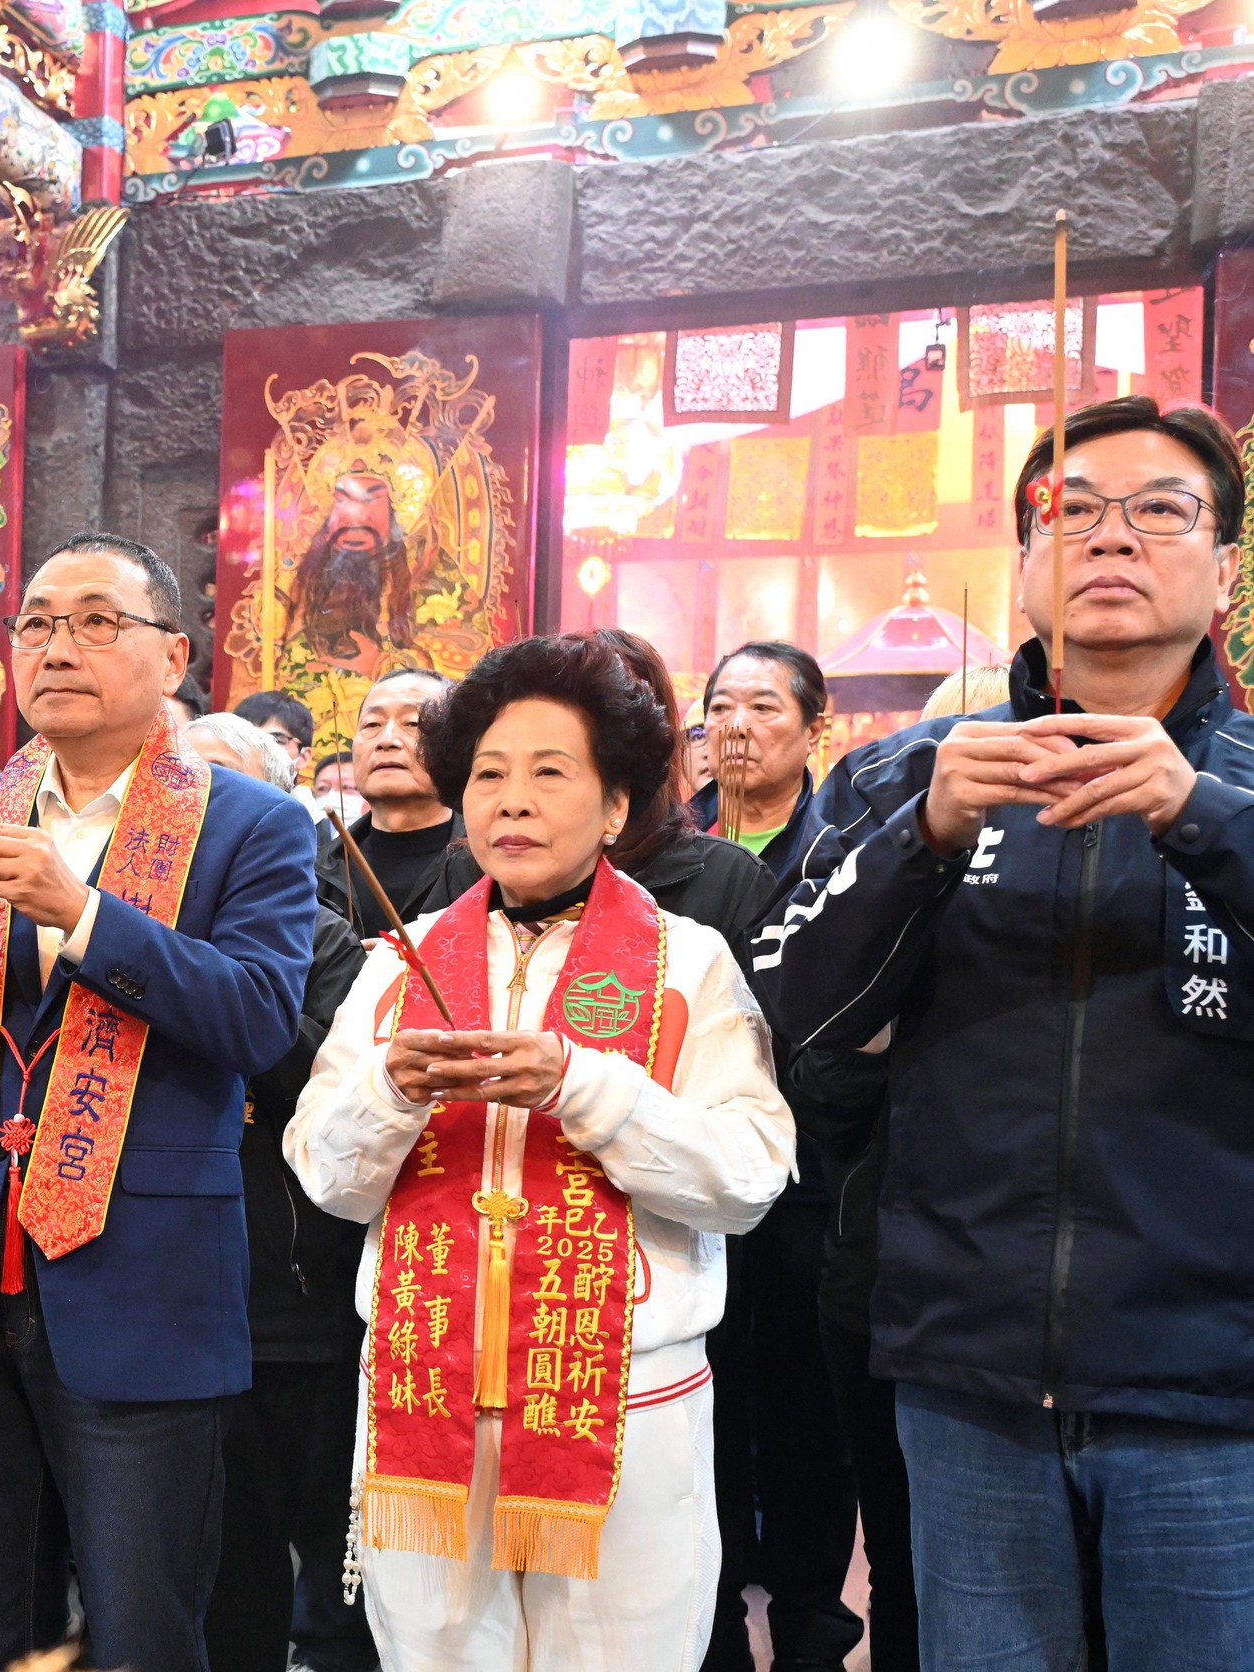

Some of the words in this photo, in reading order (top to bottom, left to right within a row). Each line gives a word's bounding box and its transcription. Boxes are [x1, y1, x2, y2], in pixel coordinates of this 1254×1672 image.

[963, 873, 1000, 885] 政府
[536, 1235, 614, 1262] 2025
[422, 1222, 455, 1419] 董事長
[523, 1258, 568, 1438] 五朝圓醮
